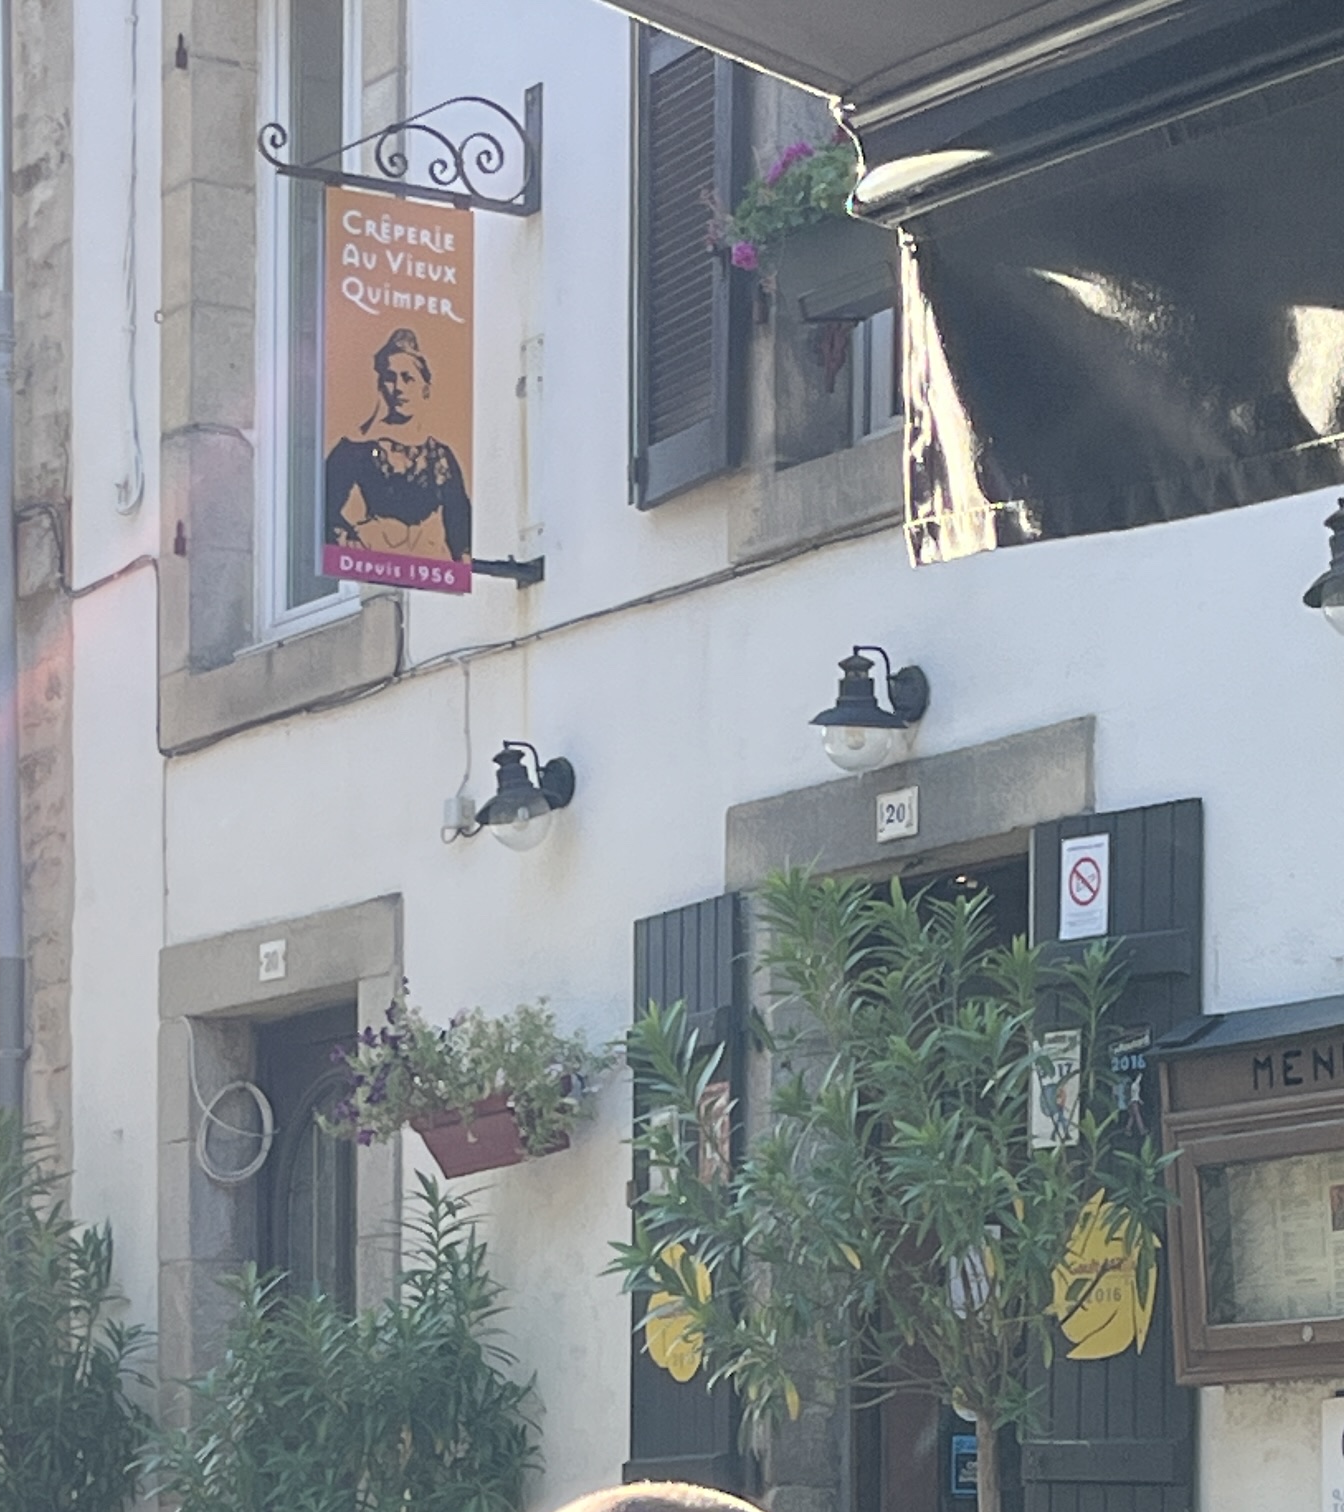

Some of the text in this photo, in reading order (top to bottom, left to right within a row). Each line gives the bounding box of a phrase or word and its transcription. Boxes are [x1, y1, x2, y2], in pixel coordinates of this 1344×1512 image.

[409, 564, 456, 586] 1956
[886, 803, 906, 824] 20
[1111, 1054, 1147, 1072] 2016
